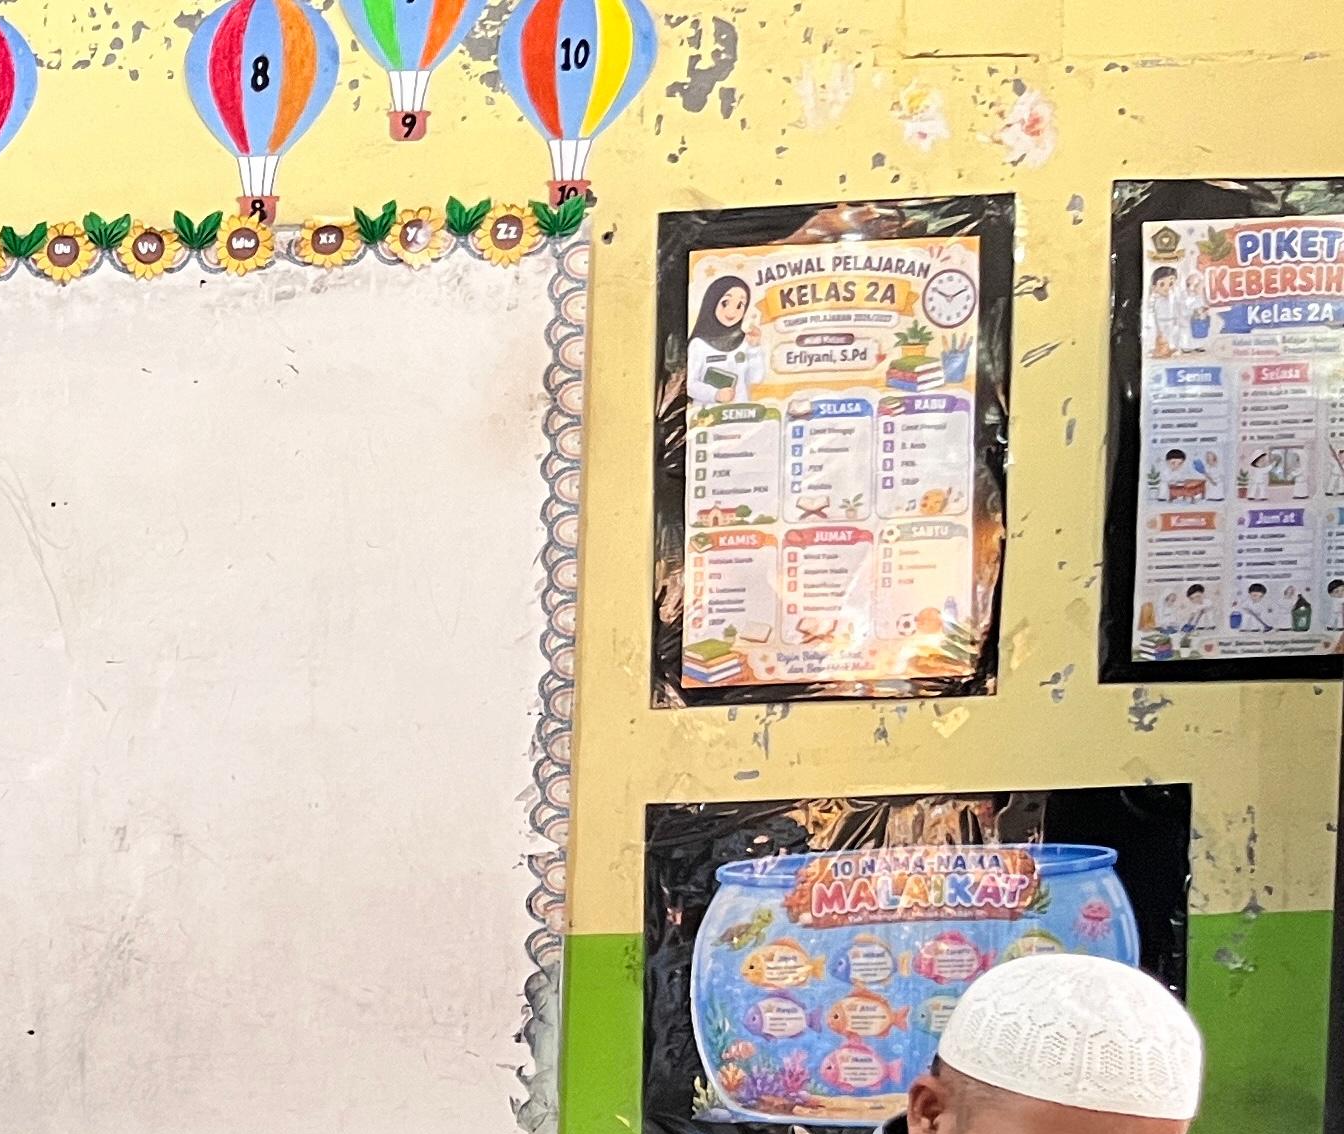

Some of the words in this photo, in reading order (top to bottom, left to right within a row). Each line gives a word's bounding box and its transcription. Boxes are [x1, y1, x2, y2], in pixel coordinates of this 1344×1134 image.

[561, 38, 590, 71] 10
[251, 55, 270, 92] 8
[401, 113, 417, 138] 9
[318, 232, 336, 245] Xx
[496, 222, 518, 241] Zz
[137, 241, 157, 255] Vv
[231, 235, 255, 250] Ww
[1237, 229, 1344, 264] PIKET
[754, 257, 826, 286] JADWAL
[832, 256, 931, 279] PELAJARAN
[779, 282, 856, 309] KELAS
[866, 283, 896, 305] 2A
[1247, 304, 1302, 325] Kelas
[1307, 303, 1334, 321] 2A
[786, 350, 837, 367] Erliyani,
[840, 348, 867, 362] S.Pd
[1177, 368, 1212, 383] Senin
[1261, 367, 1301, 381] Selasa
[819, 402, 861, 414] SELASA
[914, 399, 947, 410] RABU
[722, 409, 757, 420] SENIN
[719, 534, 757, 546] KAMIS
[814, 530, 854, 542] JUMAT
[831, 861, 854, 878] 10
[812, 874, 1030, 918] MALAIKAT
